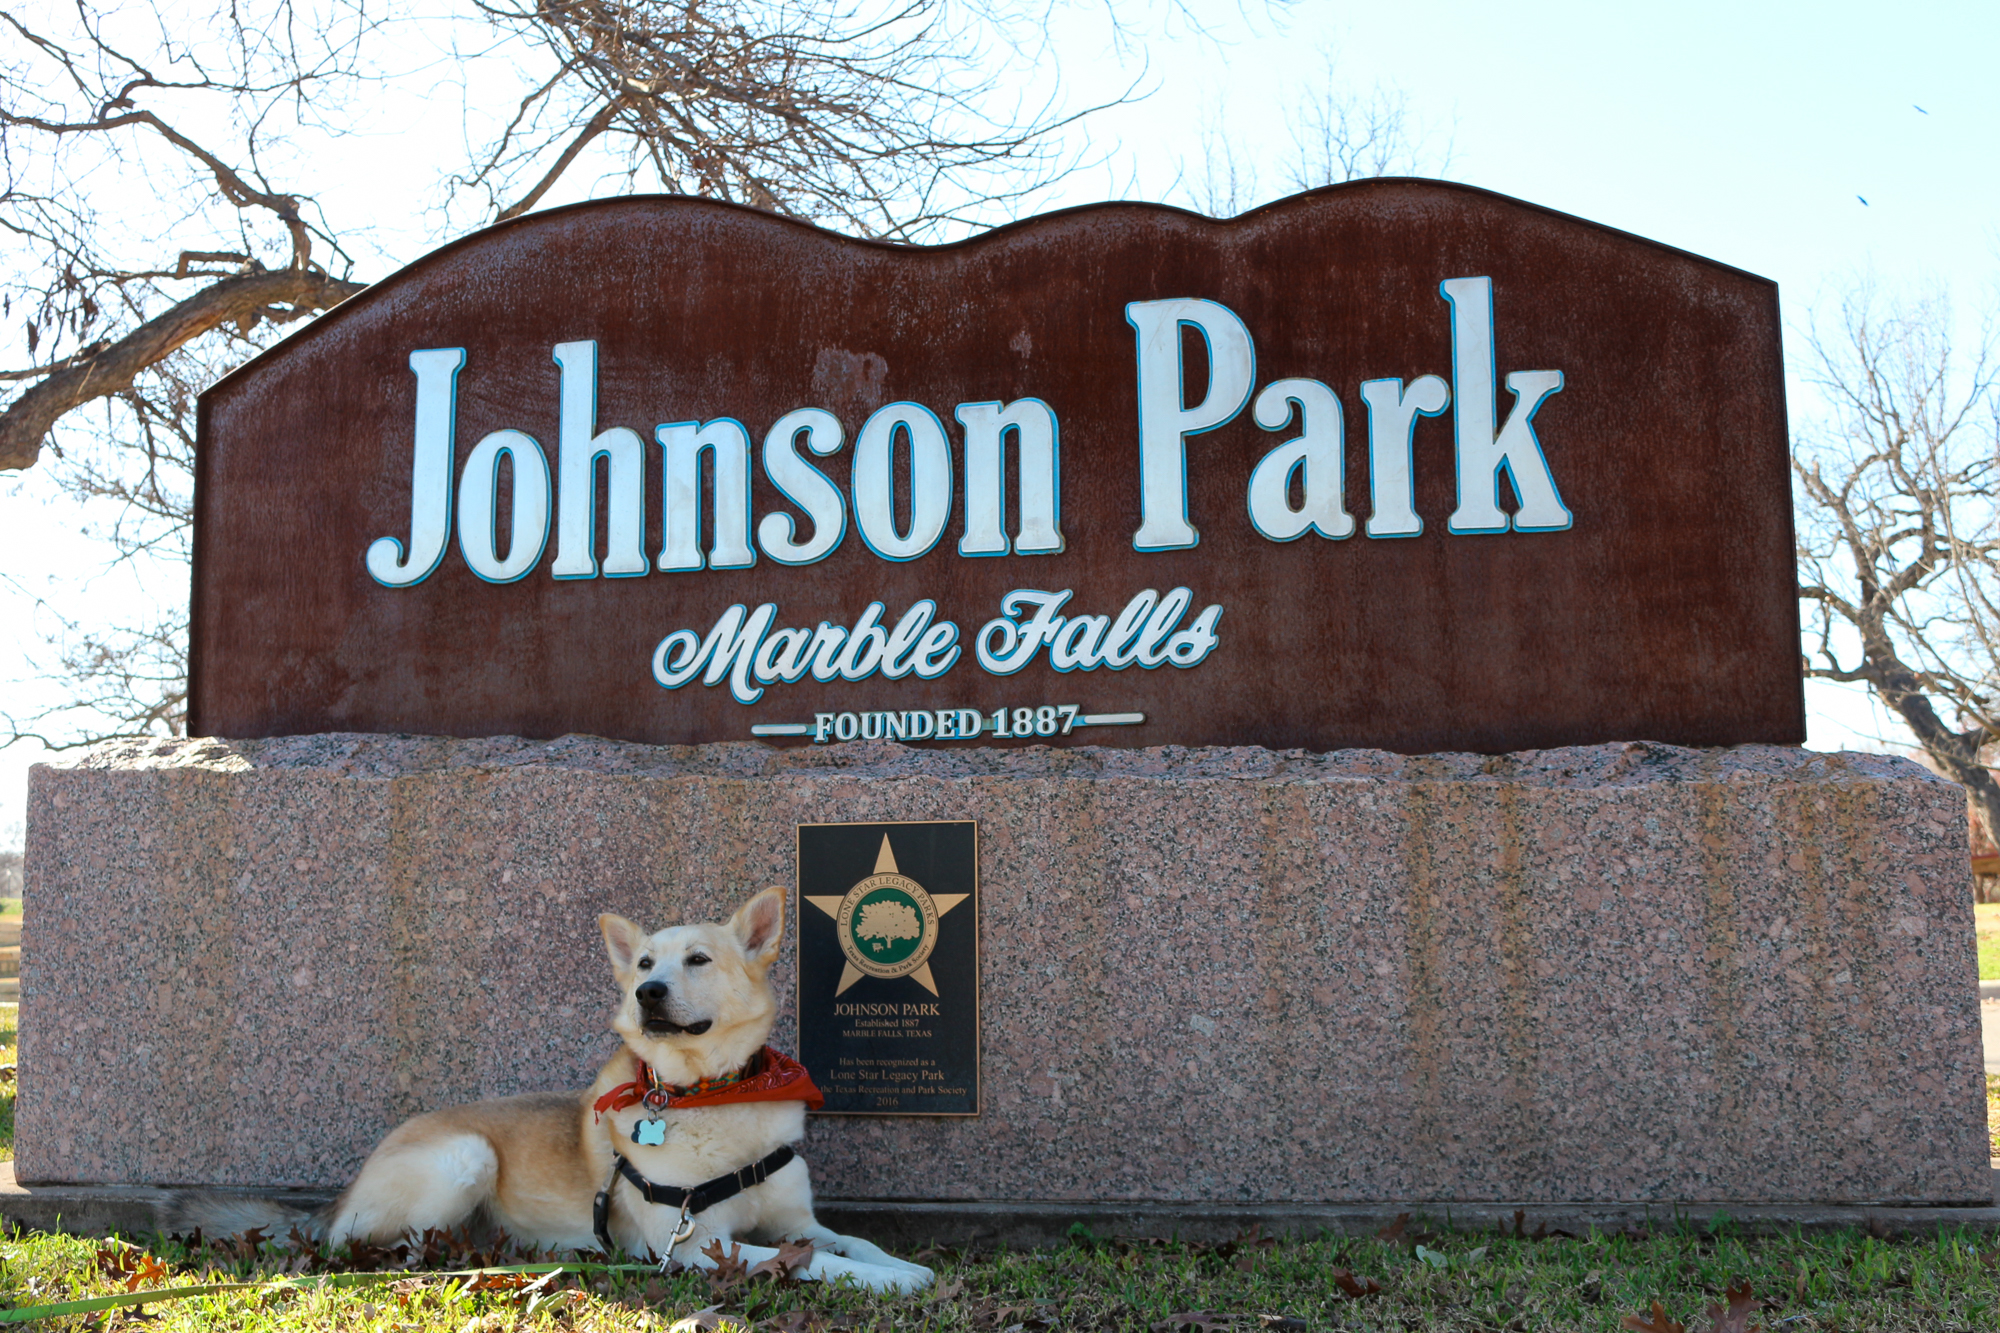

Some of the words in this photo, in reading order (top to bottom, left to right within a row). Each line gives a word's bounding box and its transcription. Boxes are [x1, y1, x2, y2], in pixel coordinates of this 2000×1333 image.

[366, 339, 1064, 588] Johnson
[1124, 275, 1573, 552] Park
[652, 600, 960, 704] Marble
[976, 587, 1223, 676] Falls
[814, 708, 984, 743] FOUNDED
[991, 704, 1080, 739] 1887
[840, 898, 856, 926] LONE
[853, 879, 877, 898] STAR
[879, 876, 920, 894] LEGACY
[917, 893, 935, 925] PARKS
[846, 945, 859, 961] Texas
[859, 957, 890, 974] Recreation
[899, 962, 913, 972] Park
[834, 1003, 898, 1016] JOHNSON
[902, 1003, 940, 1016] PARK
[855, 1019, 899, 1027] Established
[902, 1019, 919, 1027] 1887
[843, 1030, 876, 1038] MARBLE
[906, 1030, 932, 1038] TEXAS
[839, 1058, 854, 1066] Has
[856, 1058, 874, 1066] been
[876, 1058, 919, 1068] recognized
[830, 1070, 855, 1080] Lone
[858, 1070, 879, 1080] Star
[882, 1070, 919, 1082] Legacy
[921, 1070, 945, 1080] Park
[835, 1086, 856, 1094] Texas
[858, 1086, 900, 1094] Recreation
[901, 1086, 916, 1094] and
[918, 1086, 936, 1094] Park
[938, 1086, 967, 1097] Society
[876, 1097, 899, 1106] 2016
